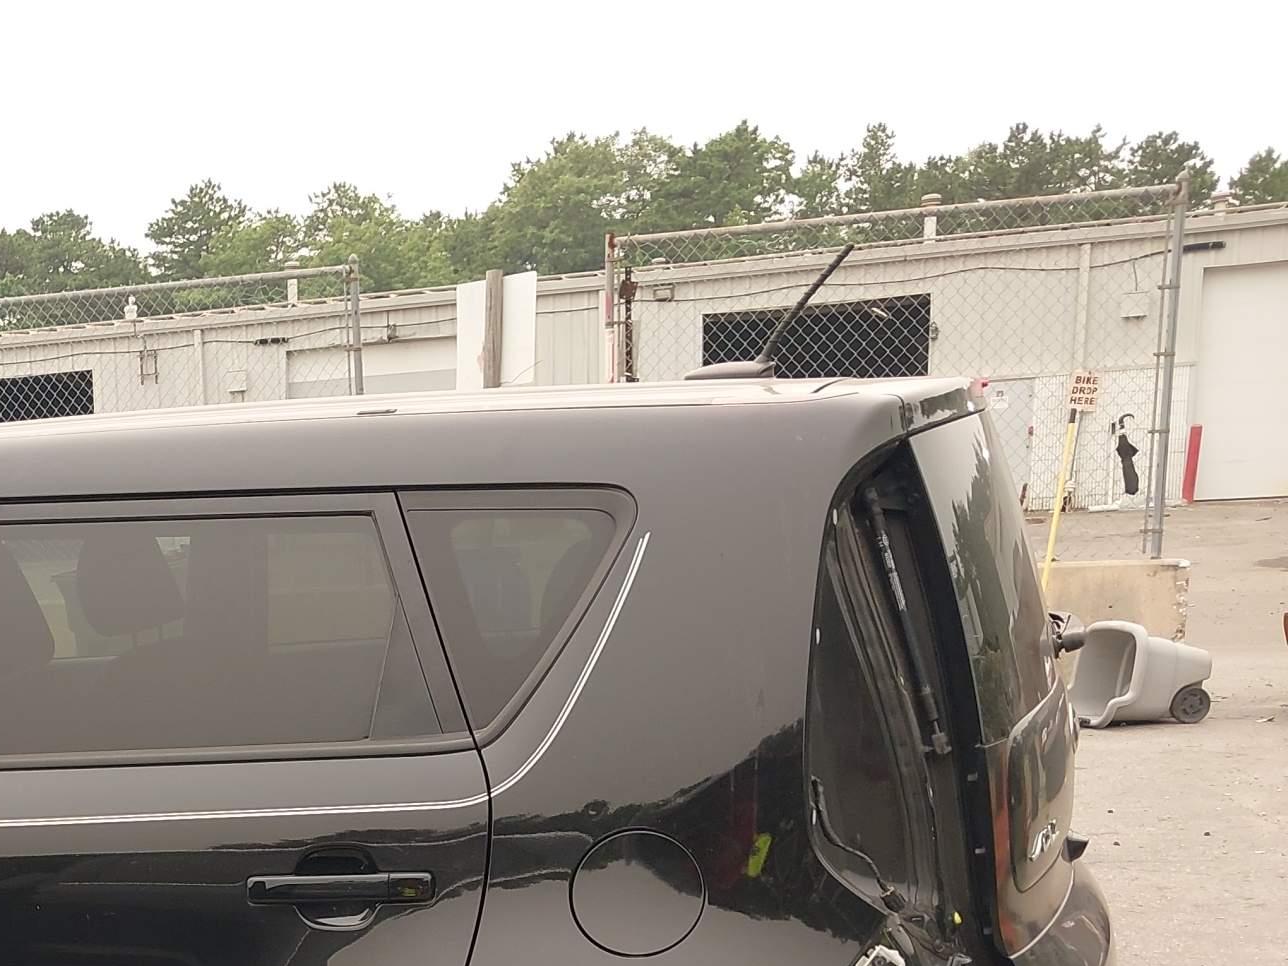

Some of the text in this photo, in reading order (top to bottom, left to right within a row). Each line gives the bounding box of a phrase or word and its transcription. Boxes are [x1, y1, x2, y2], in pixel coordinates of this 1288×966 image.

[1074, 375, 1098, 385] BIKE
[1071, 386, 1098, 395] DROP
[1069, 396, 1096, 405] HERE
